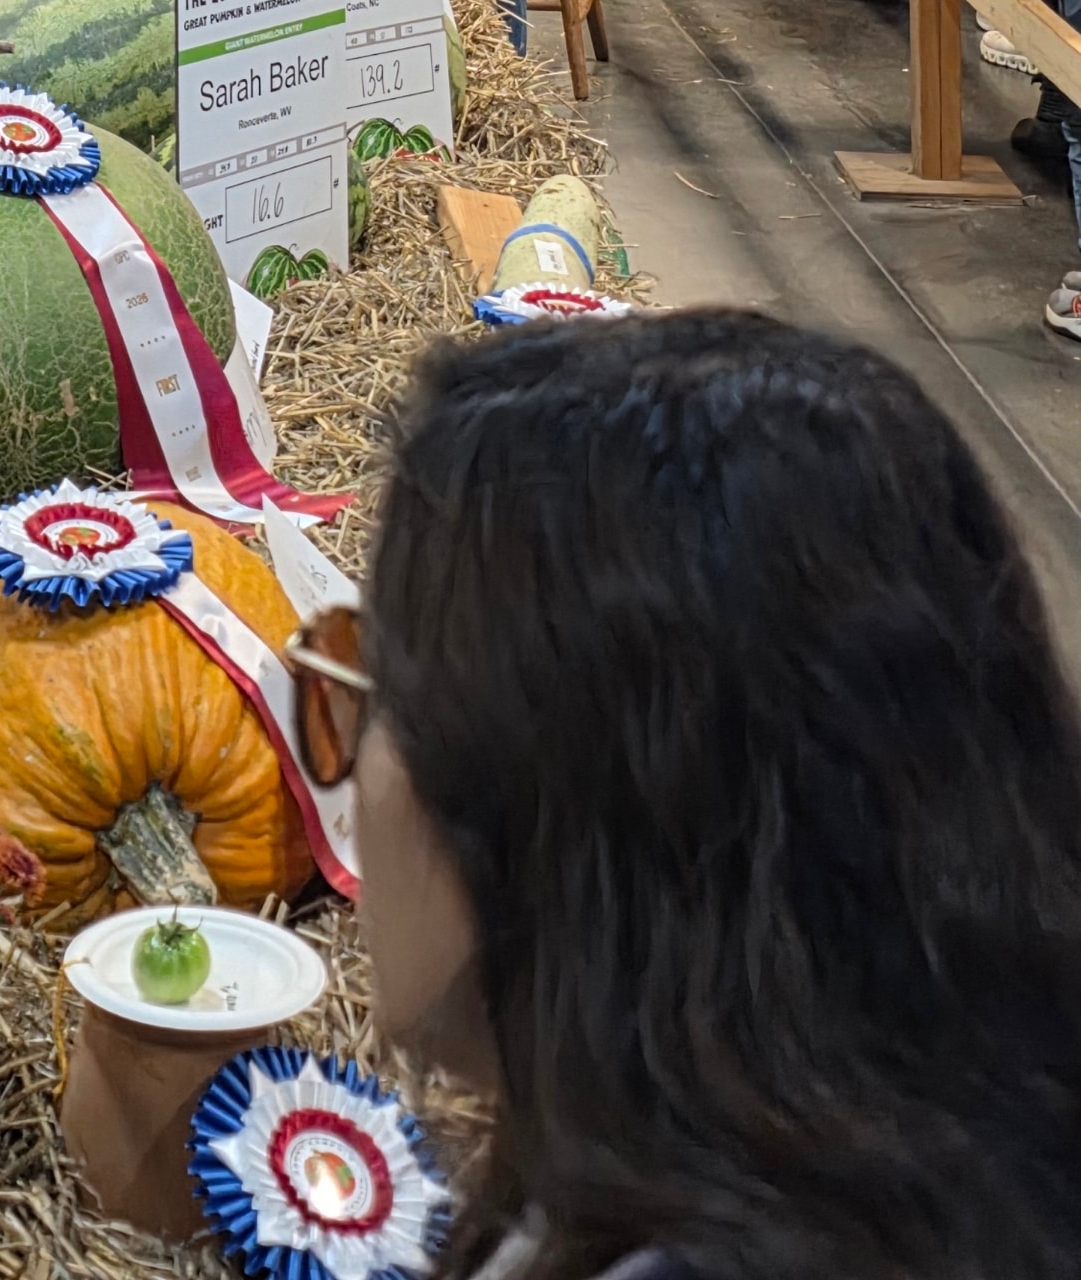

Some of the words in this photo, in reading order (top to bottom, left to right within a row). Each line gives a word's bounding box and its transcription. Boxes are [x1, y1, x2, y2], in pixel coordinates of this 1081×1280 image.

[184, 16, 207, 31] GREAT
[210, 7, 243, 24] PUMPKIN
[246, 5, 252, 15] &
[225, 39, 246, 50] GIANT
[248, 28, 284, 46] WATERMELON
[285, 23, 304, 37] ENTRY
[199, 68, 262, 112] Sarah
[269, 55, 329, 93] Baker
[360, 59, 404, 98] 139.2
[280, 106, 292, 117] WV
[252, 182, 284, 224] 16.6
[125, 292, 149, 309] 2026
[155, 374, 181, 397] FIRST
